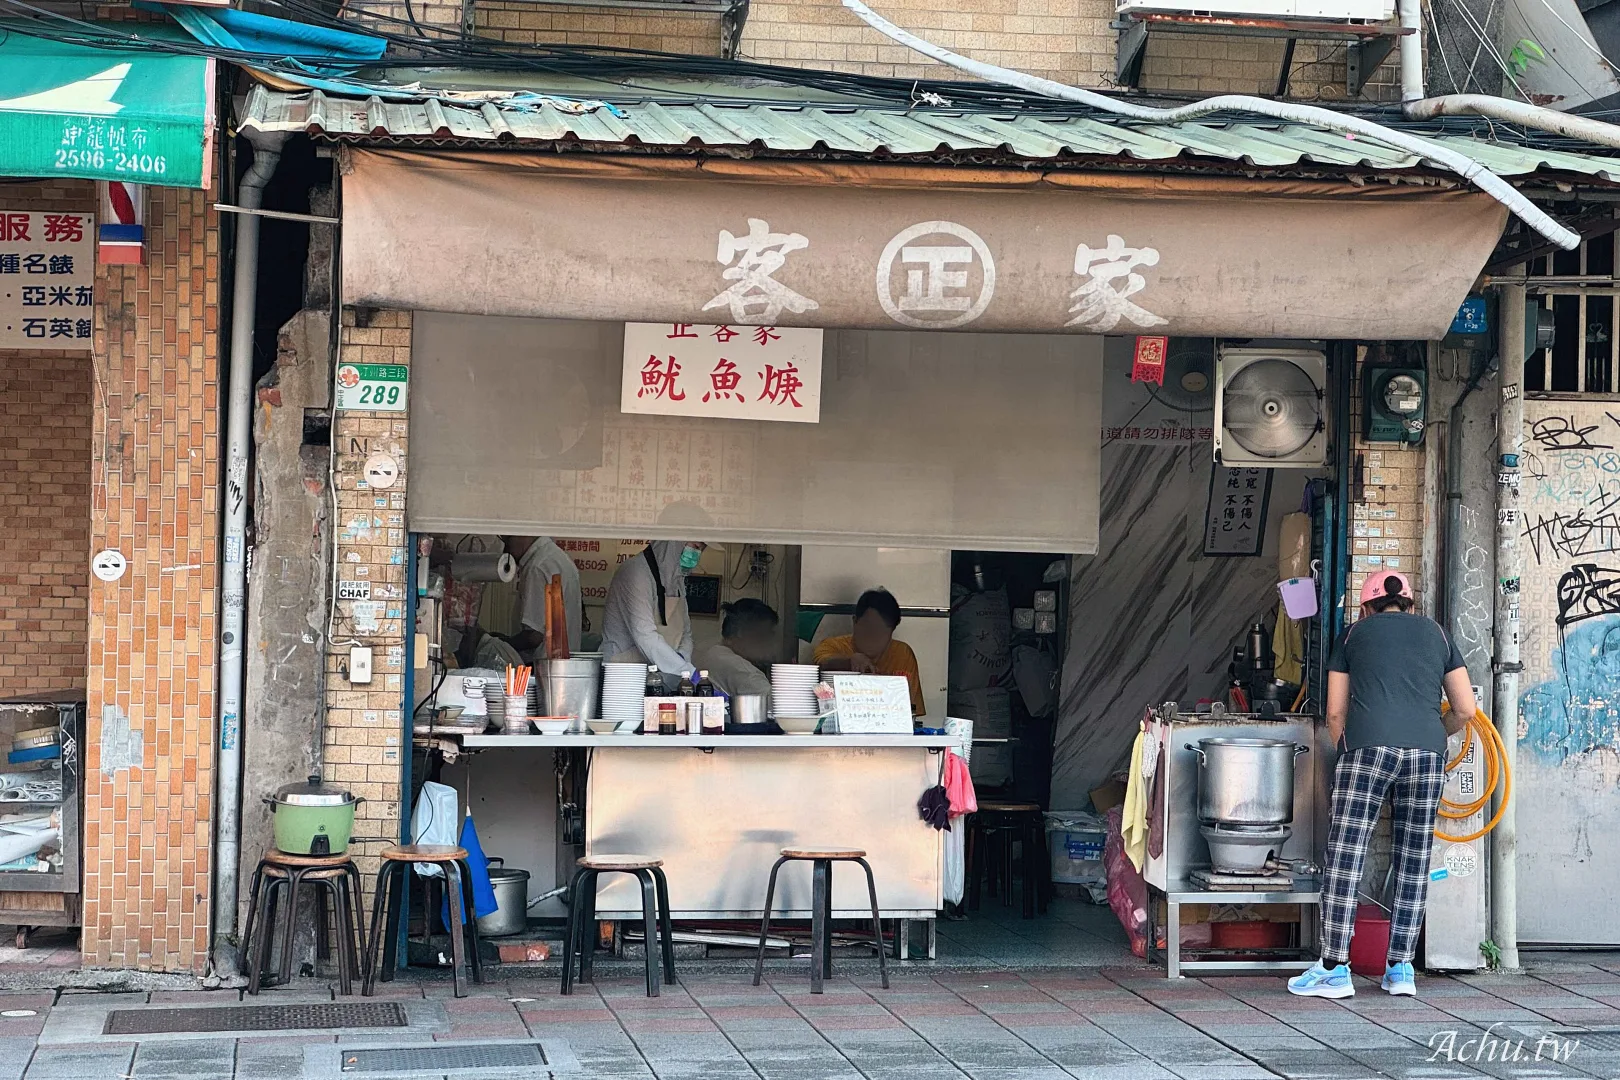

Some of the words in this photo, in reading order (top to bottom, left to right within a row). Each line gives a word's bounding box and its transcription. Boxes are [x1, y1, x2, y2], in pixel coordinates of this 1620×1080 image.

[55, 149, 166, 174] 2596-2406
[0, 213, 83, 242] 服務
[0, 253, 74, 275] 種名錶
[637, 354, 804, 408] 魷魚焿
[359, 385, 400, 405] 289
[1101, 427, 1213, 440] 道請勿排隊等
[340, 589, 369, 598] CHAF
